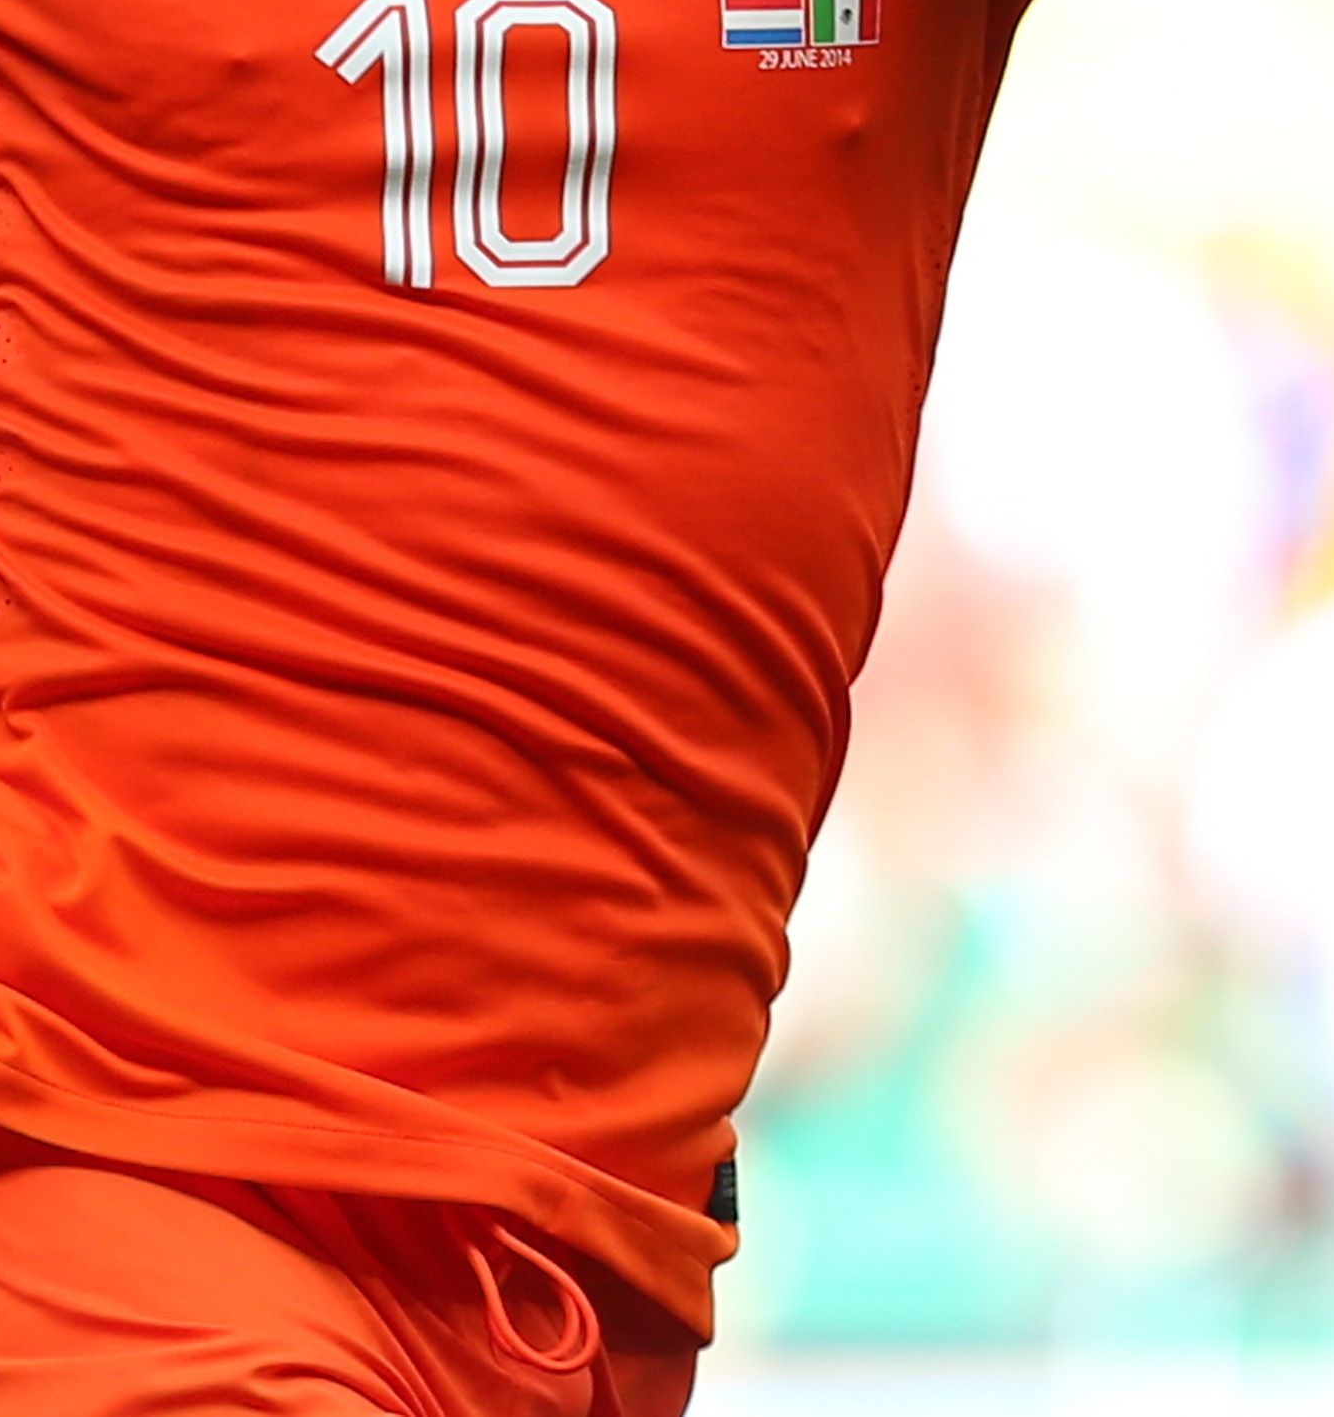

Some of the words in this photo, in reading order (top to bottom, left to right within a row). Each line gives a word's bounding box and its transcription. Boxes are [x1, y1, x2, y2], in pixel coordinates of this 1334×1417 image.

[758, 49, 779, 70] 29
[779, 48, 818, 69] JUNE
[819, 48, 853, 68] 2014
